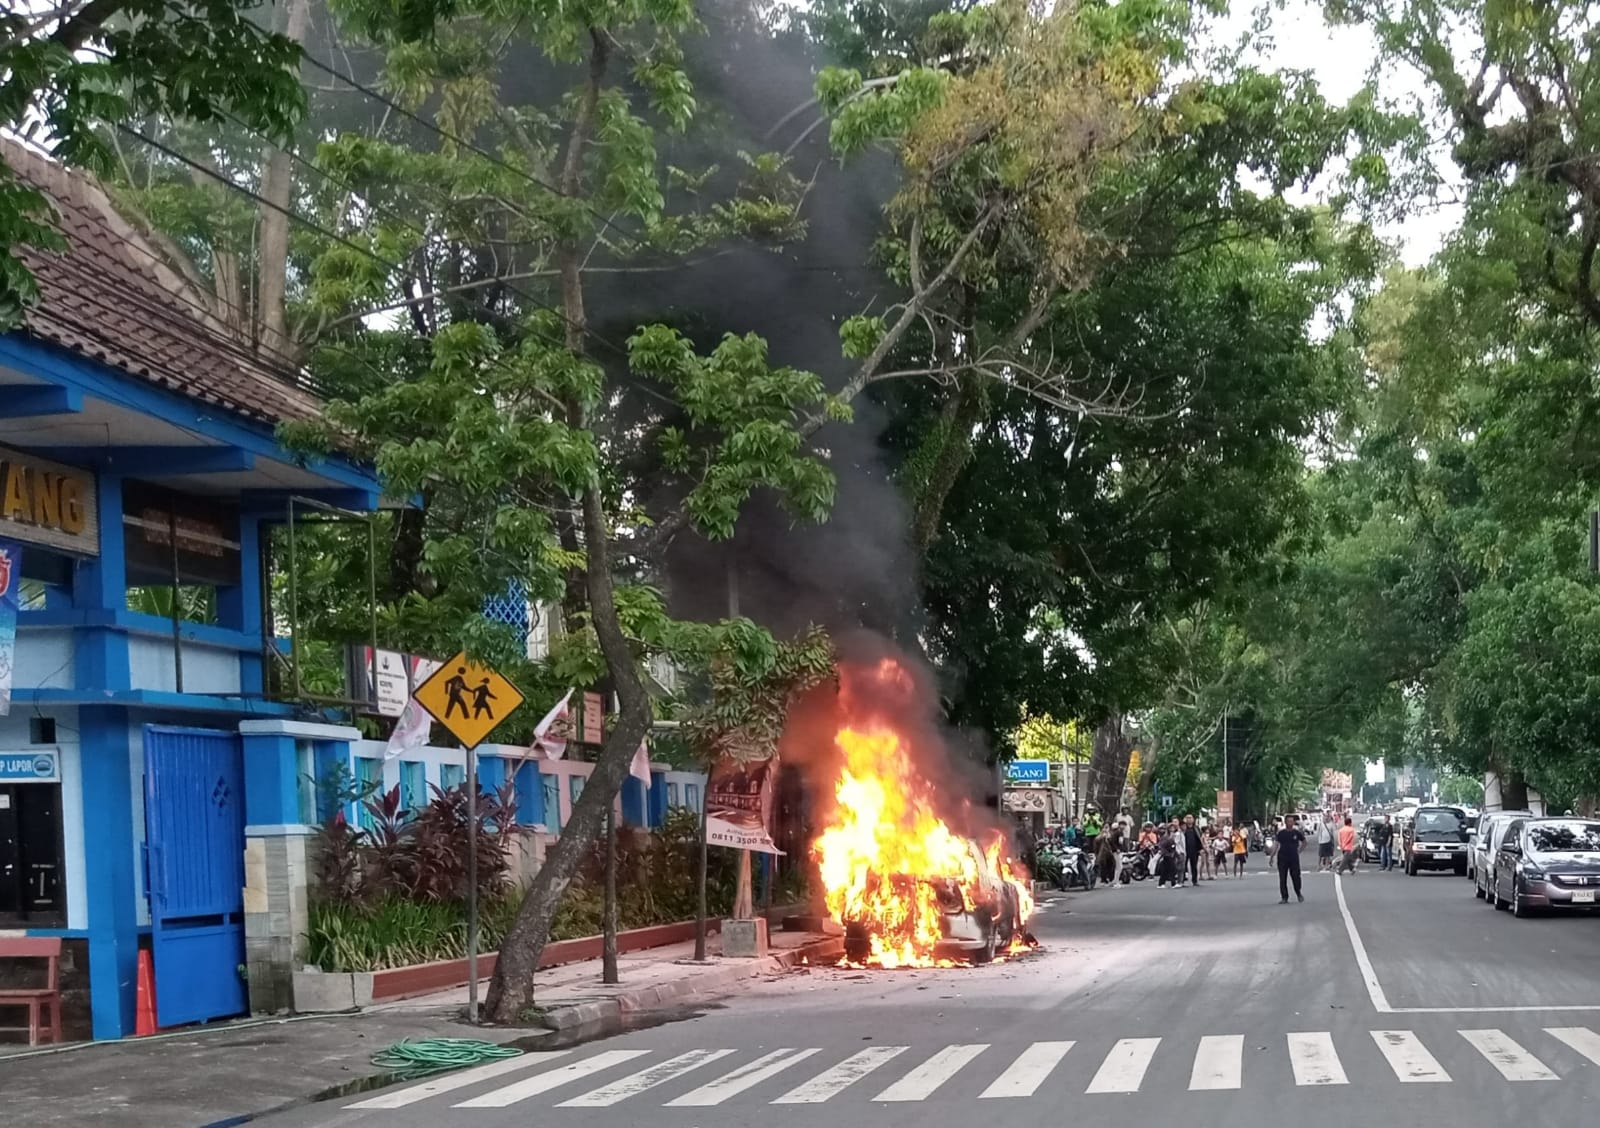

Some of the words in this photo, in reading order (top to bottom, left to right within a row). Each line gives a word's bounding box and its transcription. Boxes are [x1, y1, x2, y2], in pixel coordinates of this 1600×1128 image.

[3, 462, 84, 534] ANG
[7, 760, 33, 773] LAPOR
[711, 832, 734, 842] 0811
[736, 836, 758, 845] 3500
